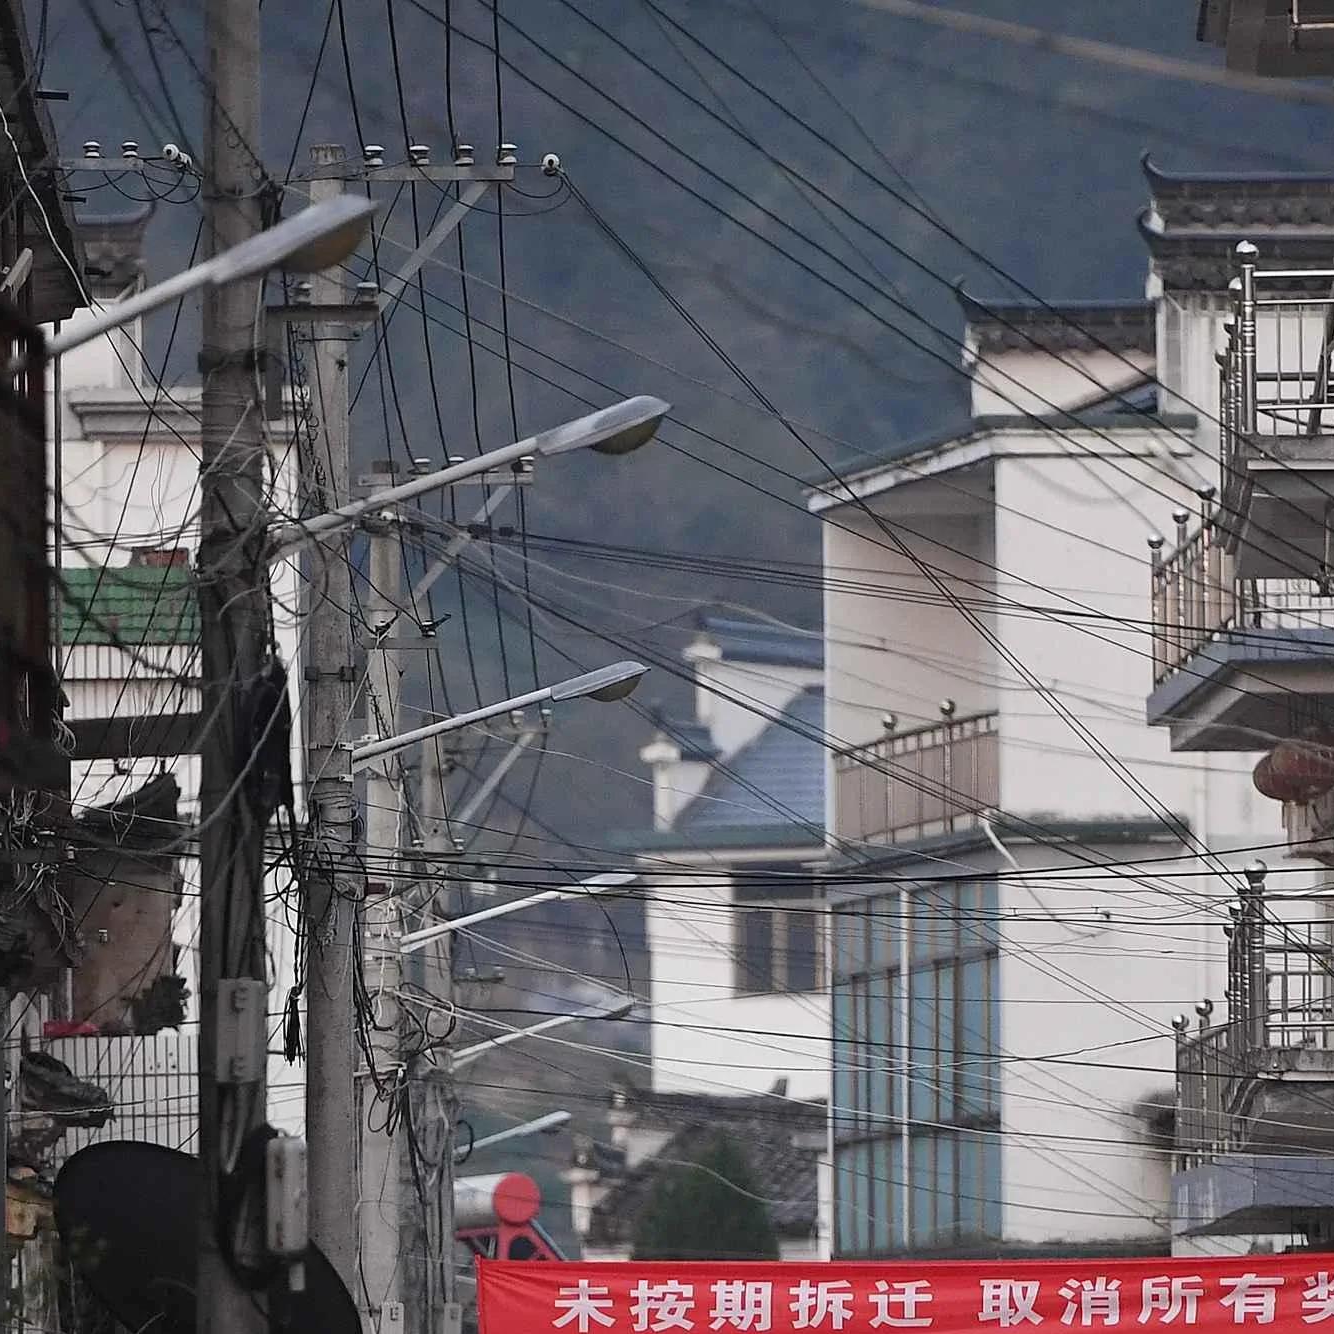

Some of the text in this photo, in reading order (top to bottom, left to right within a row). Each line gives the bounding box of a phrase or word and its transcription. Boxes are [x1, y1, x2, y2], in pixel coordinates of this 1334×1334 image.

[552, 1279, 934, 1333] 未按期拆迁
